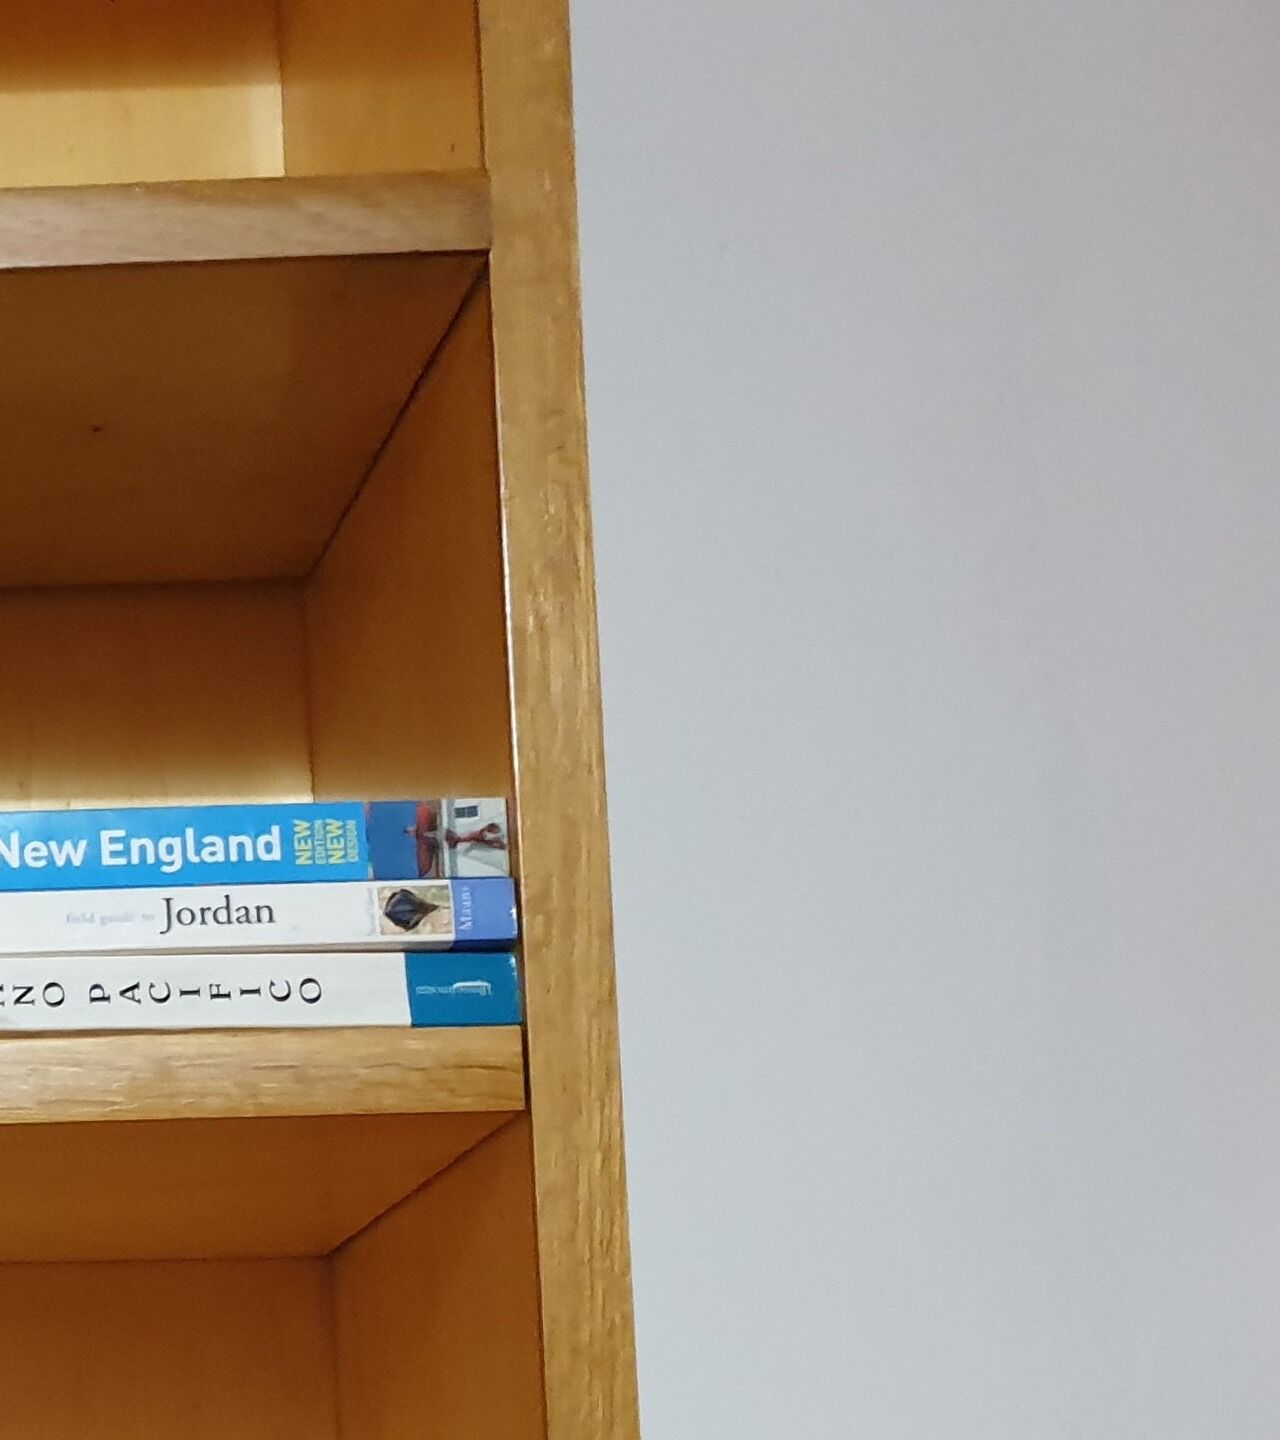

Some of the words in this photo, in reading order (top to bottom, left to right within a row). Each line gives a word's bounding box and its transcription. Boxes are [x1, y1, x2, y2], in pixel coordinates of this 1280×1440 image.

[100, 824, 282, 873] England
[294, 820, 314, 865] NEW
[326, 818, 346, 865] NEW
[160, 895, 276, 934] Jordan
[90, 977, 322, 1006] PACIFICO
